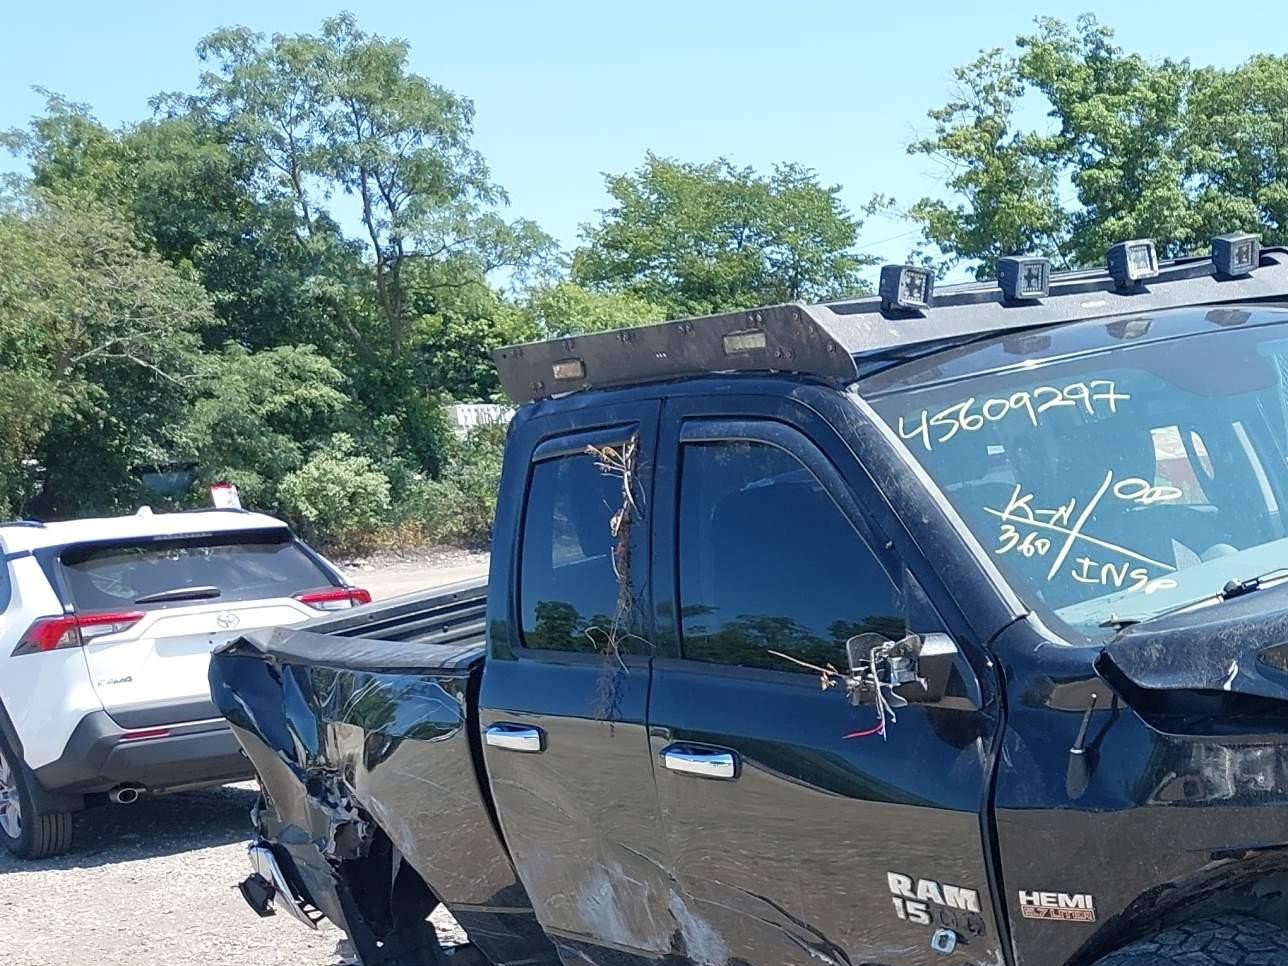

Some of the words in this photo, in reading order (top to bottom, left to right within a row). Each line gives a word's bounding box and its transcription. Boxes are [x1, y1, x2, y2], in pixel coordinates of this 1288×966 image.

[899, 380, 1131, 450] 45609297
[995, 524, 1050, 557] 360
[887, 871, 980, 913] RAM
[1019, 890, 1093, 909] HEMI
[892, 896, 931, 925] 15
